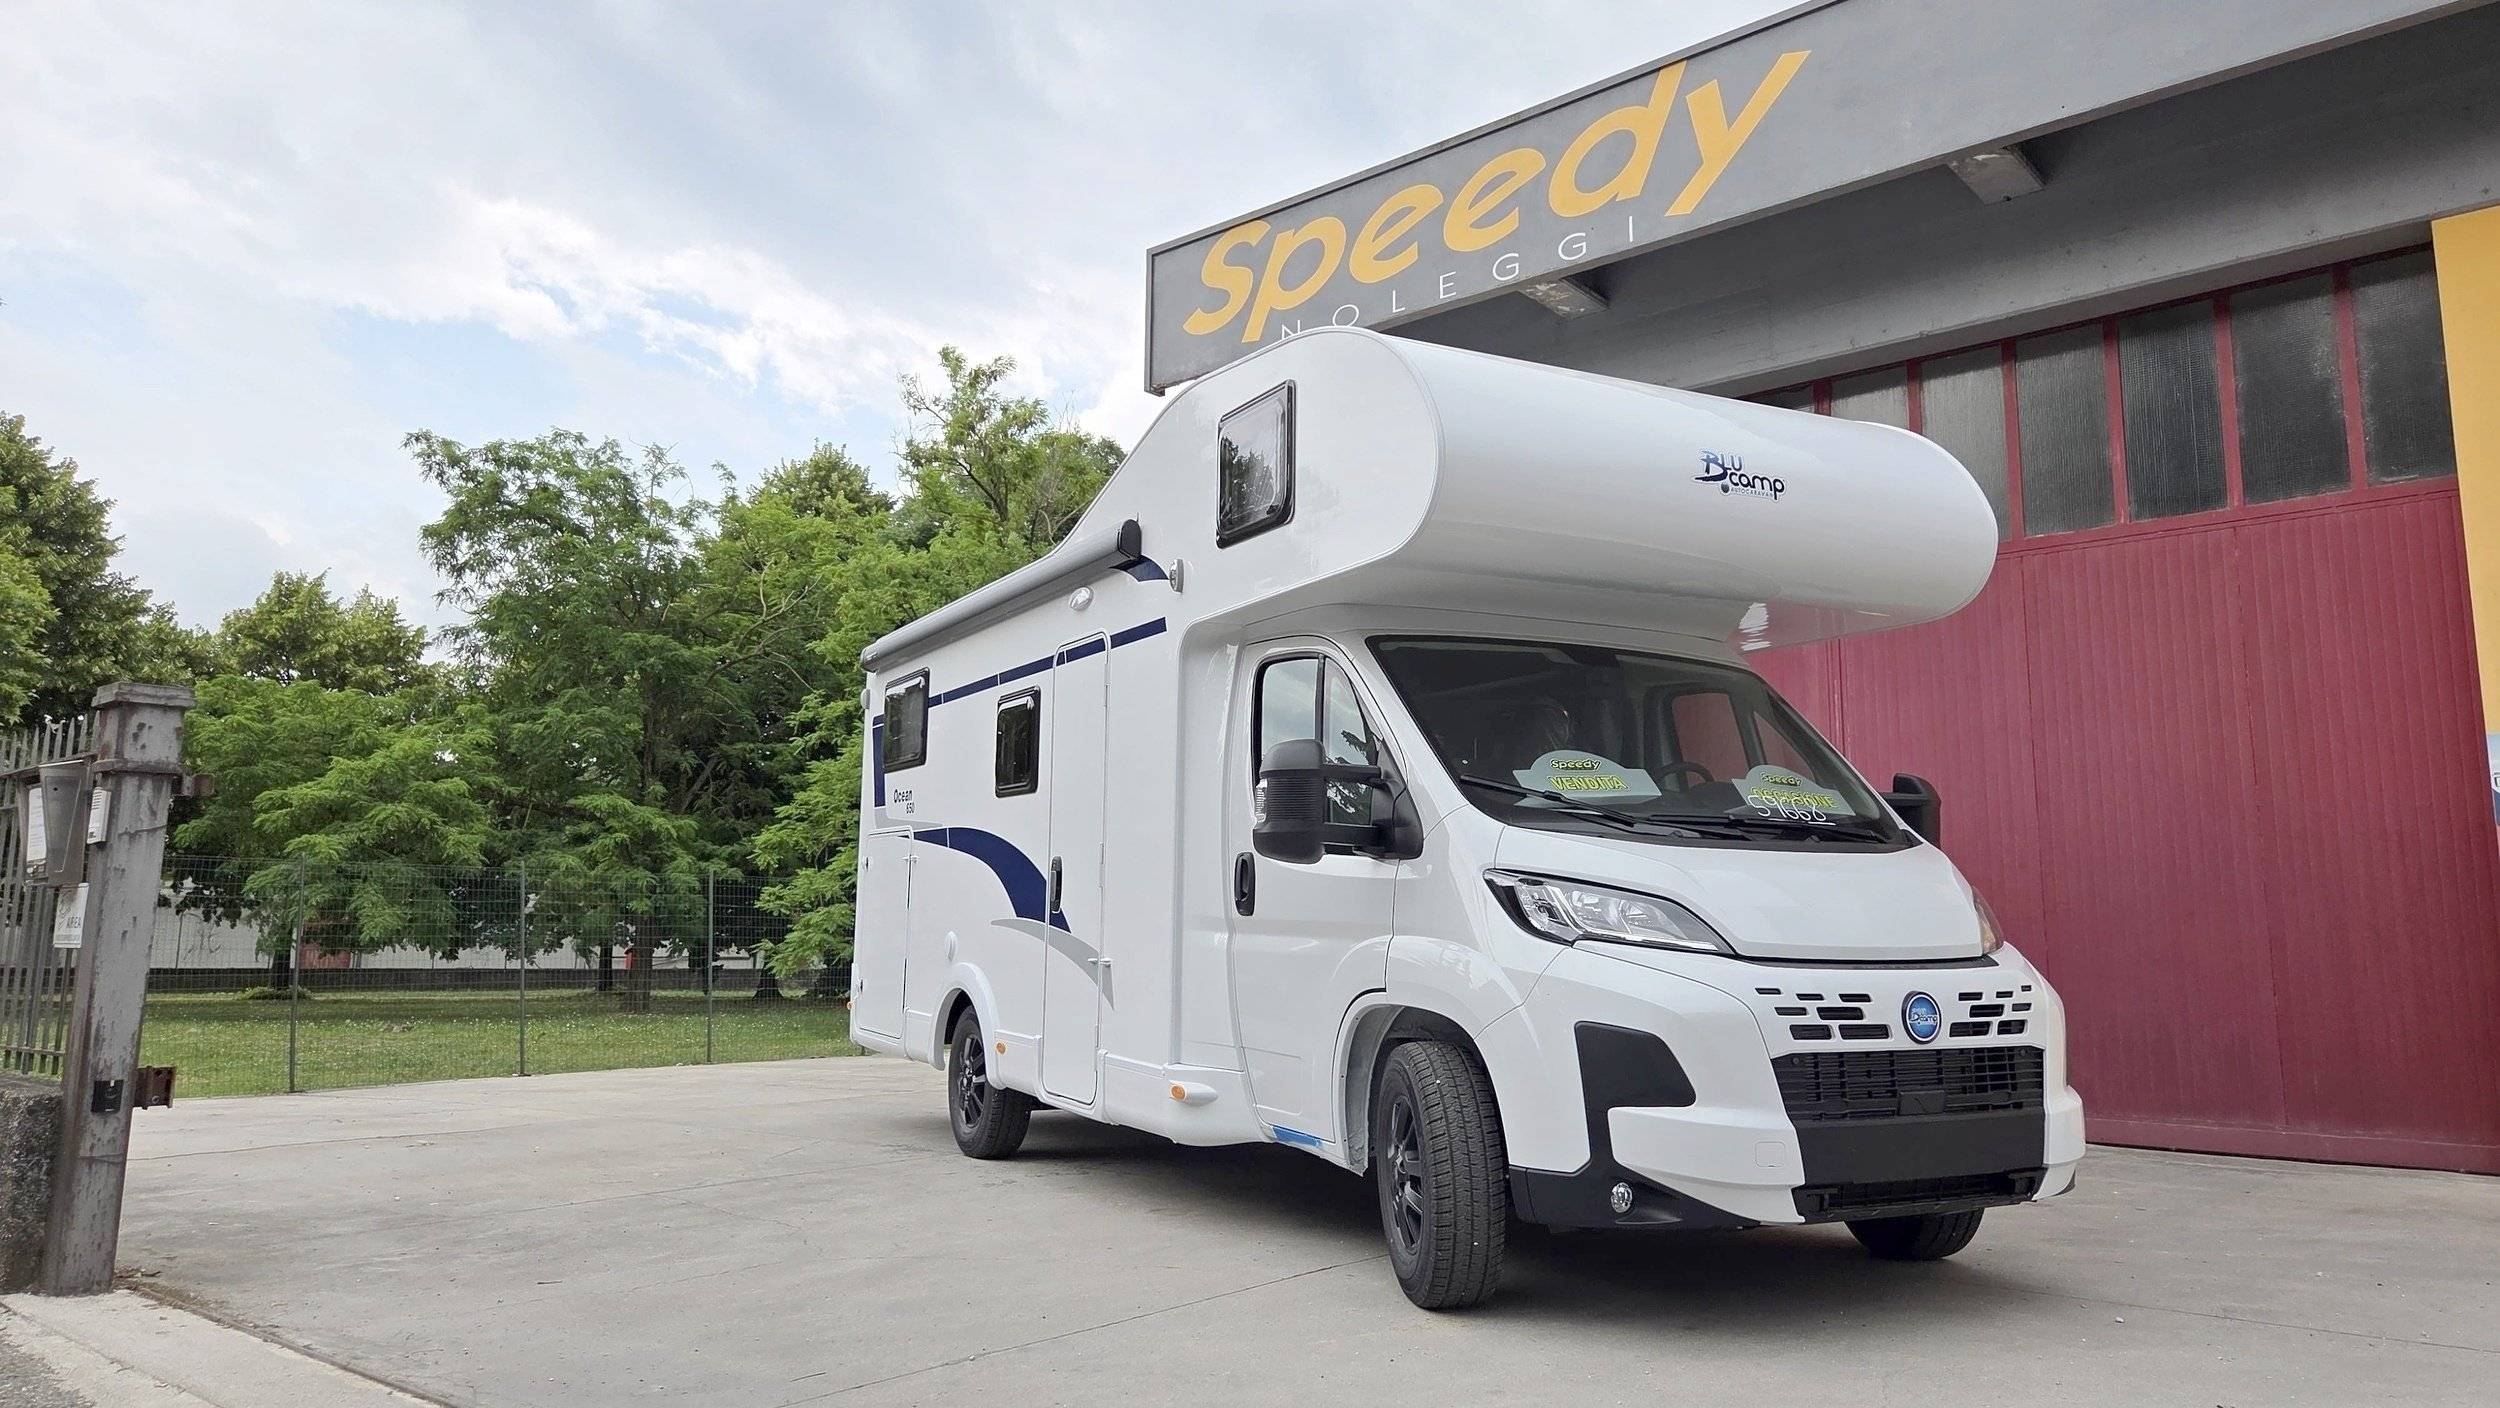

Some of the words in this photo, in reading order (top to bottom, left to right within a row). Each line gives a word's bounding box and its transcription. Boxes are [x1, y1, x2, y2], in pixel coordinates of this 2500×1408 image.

[1183, 50, 1811, 343] Speedy
[1280, 215, 1636, 340] NOLEGGI
[1728, 471, 1785, 500] camp
[1551, 759, 1600, 770] Speedy
[1549, 775, 1628, 790] VENDITA
[1761, 773, 1802, 786] Speedy
[893, 789, 913, 803] Ocean
